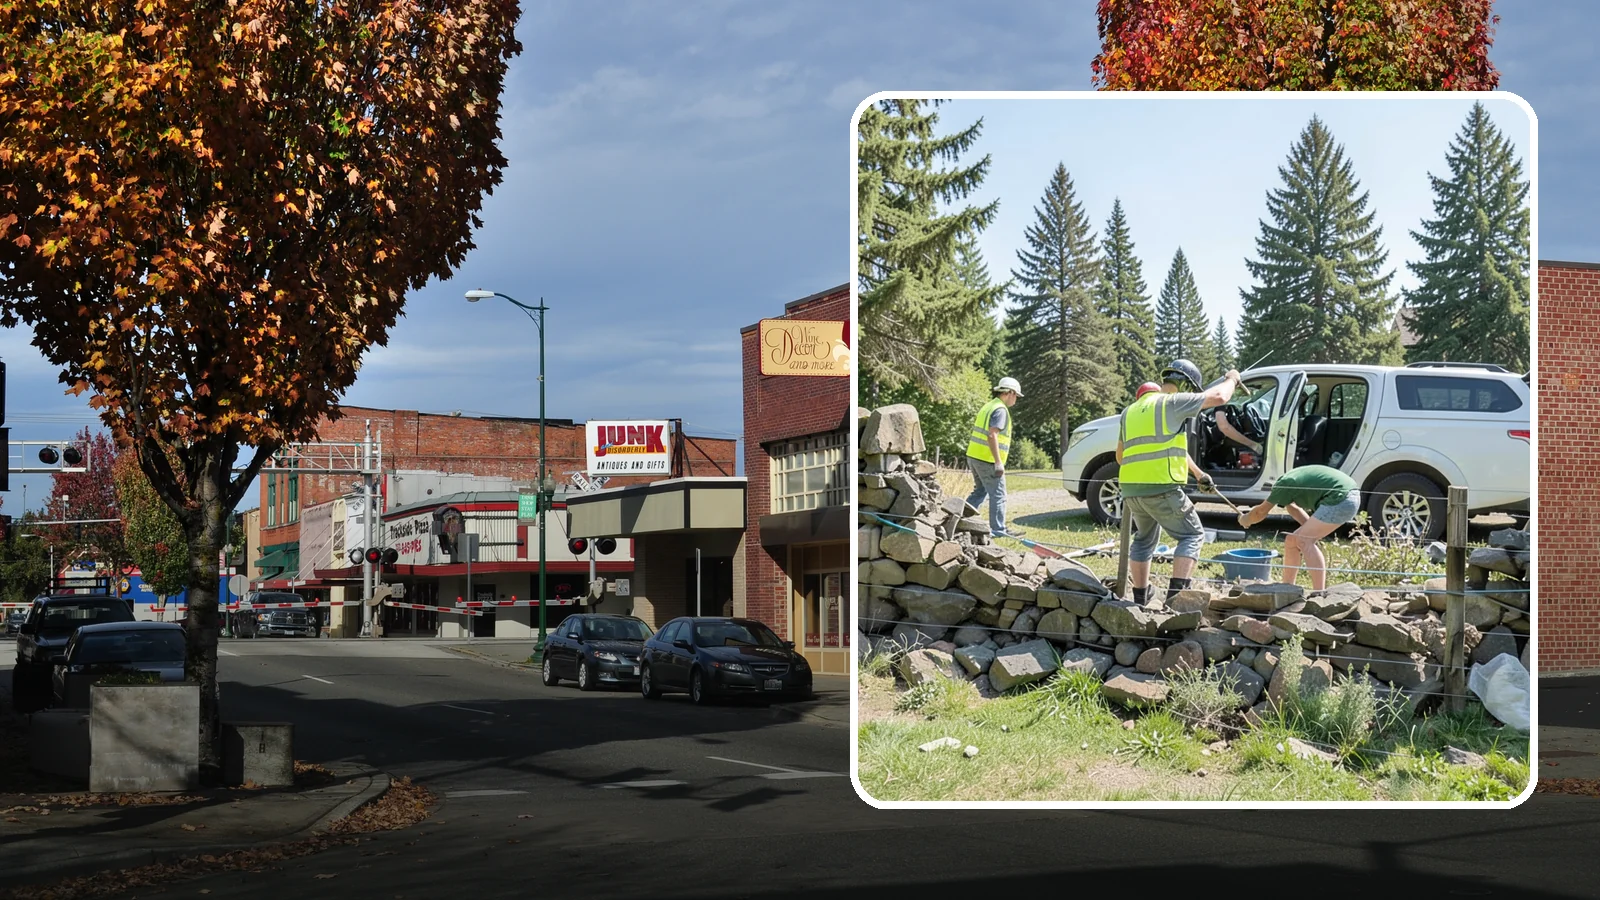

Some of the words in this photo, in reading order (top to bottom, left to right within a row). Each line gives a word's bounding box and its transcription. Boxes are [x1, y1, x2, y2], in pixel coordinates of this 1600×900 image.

[595, 425, 666, 457] JUNK
[607, 446, 646, 454] DISORDERLY
[597, 461, 628, 470] ANTIQUES
[631, 461, 643, 470] AND
[647, 461, 665, 470] GIFTS
[573, 473, 588, 491] RAIL
[390, 521, 413, 539] Trackside
[415, 520, 429, 535] Pizza
